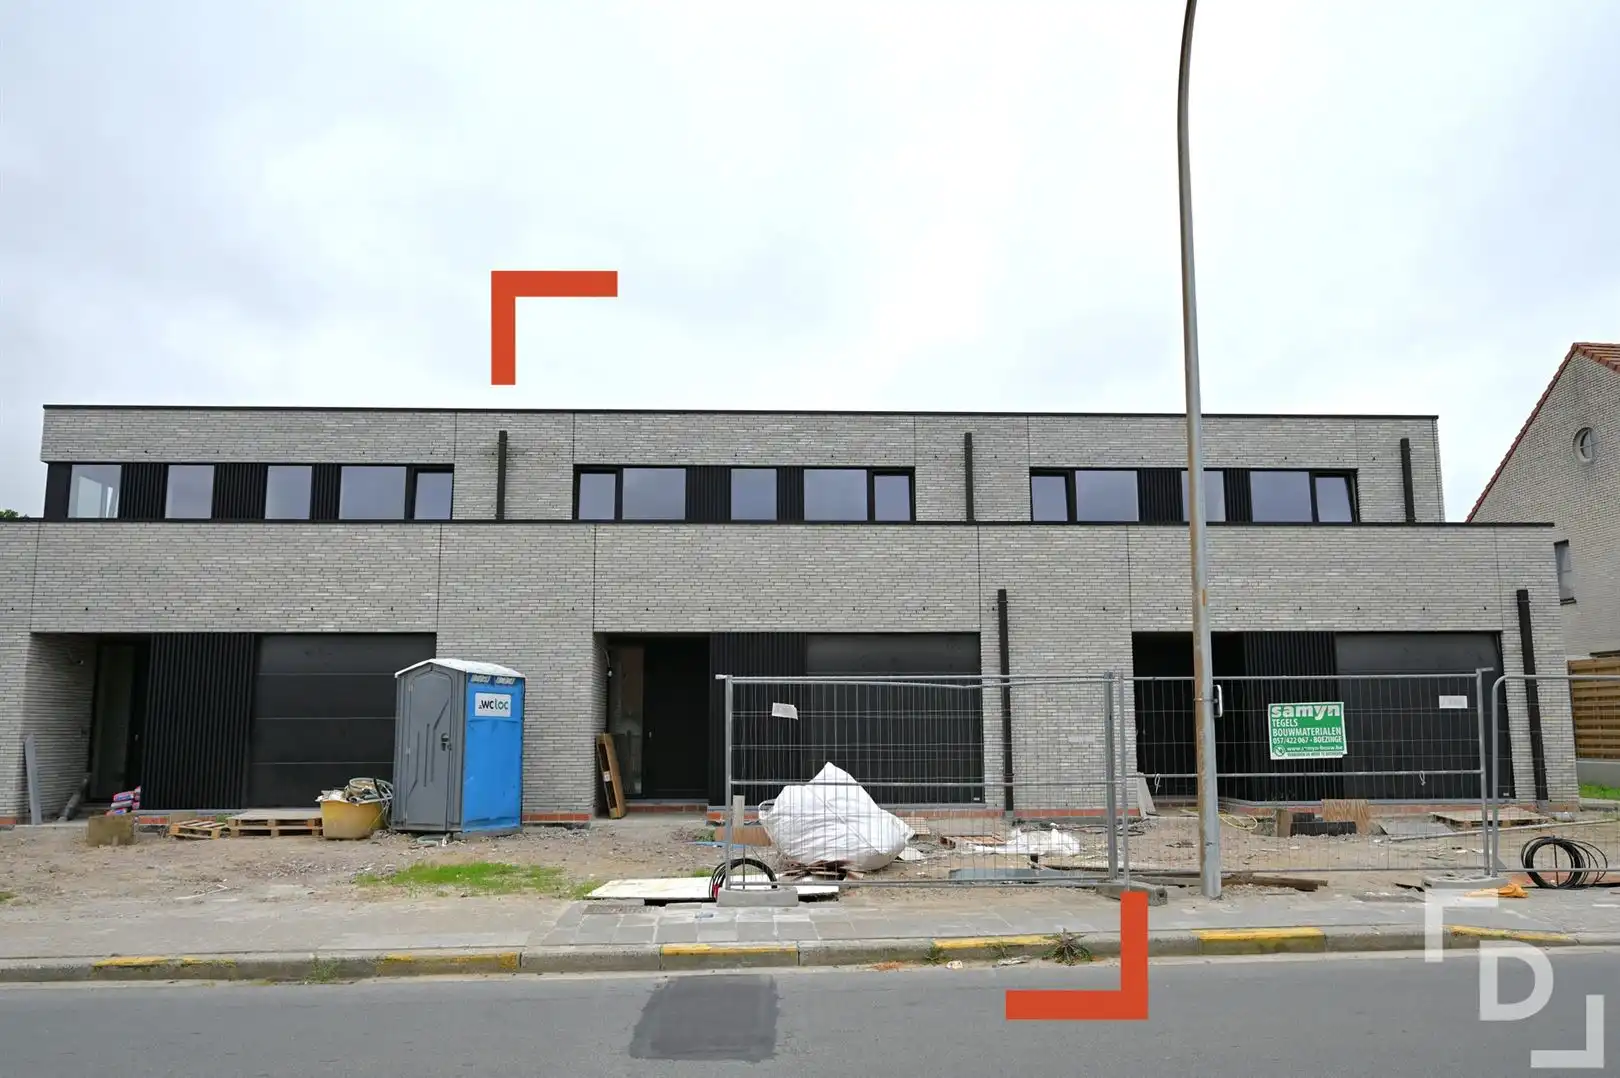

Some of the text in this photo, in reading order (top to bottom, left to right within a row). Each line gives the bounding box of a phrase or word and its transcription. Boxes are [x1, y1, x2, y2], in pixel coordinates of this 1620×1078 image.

[1271, 704, 1340, 720] samyn
[1272, 718, 1298, 727] TEGELS
[1272, 727, 1342, 736] BOUWMATERIALEN
